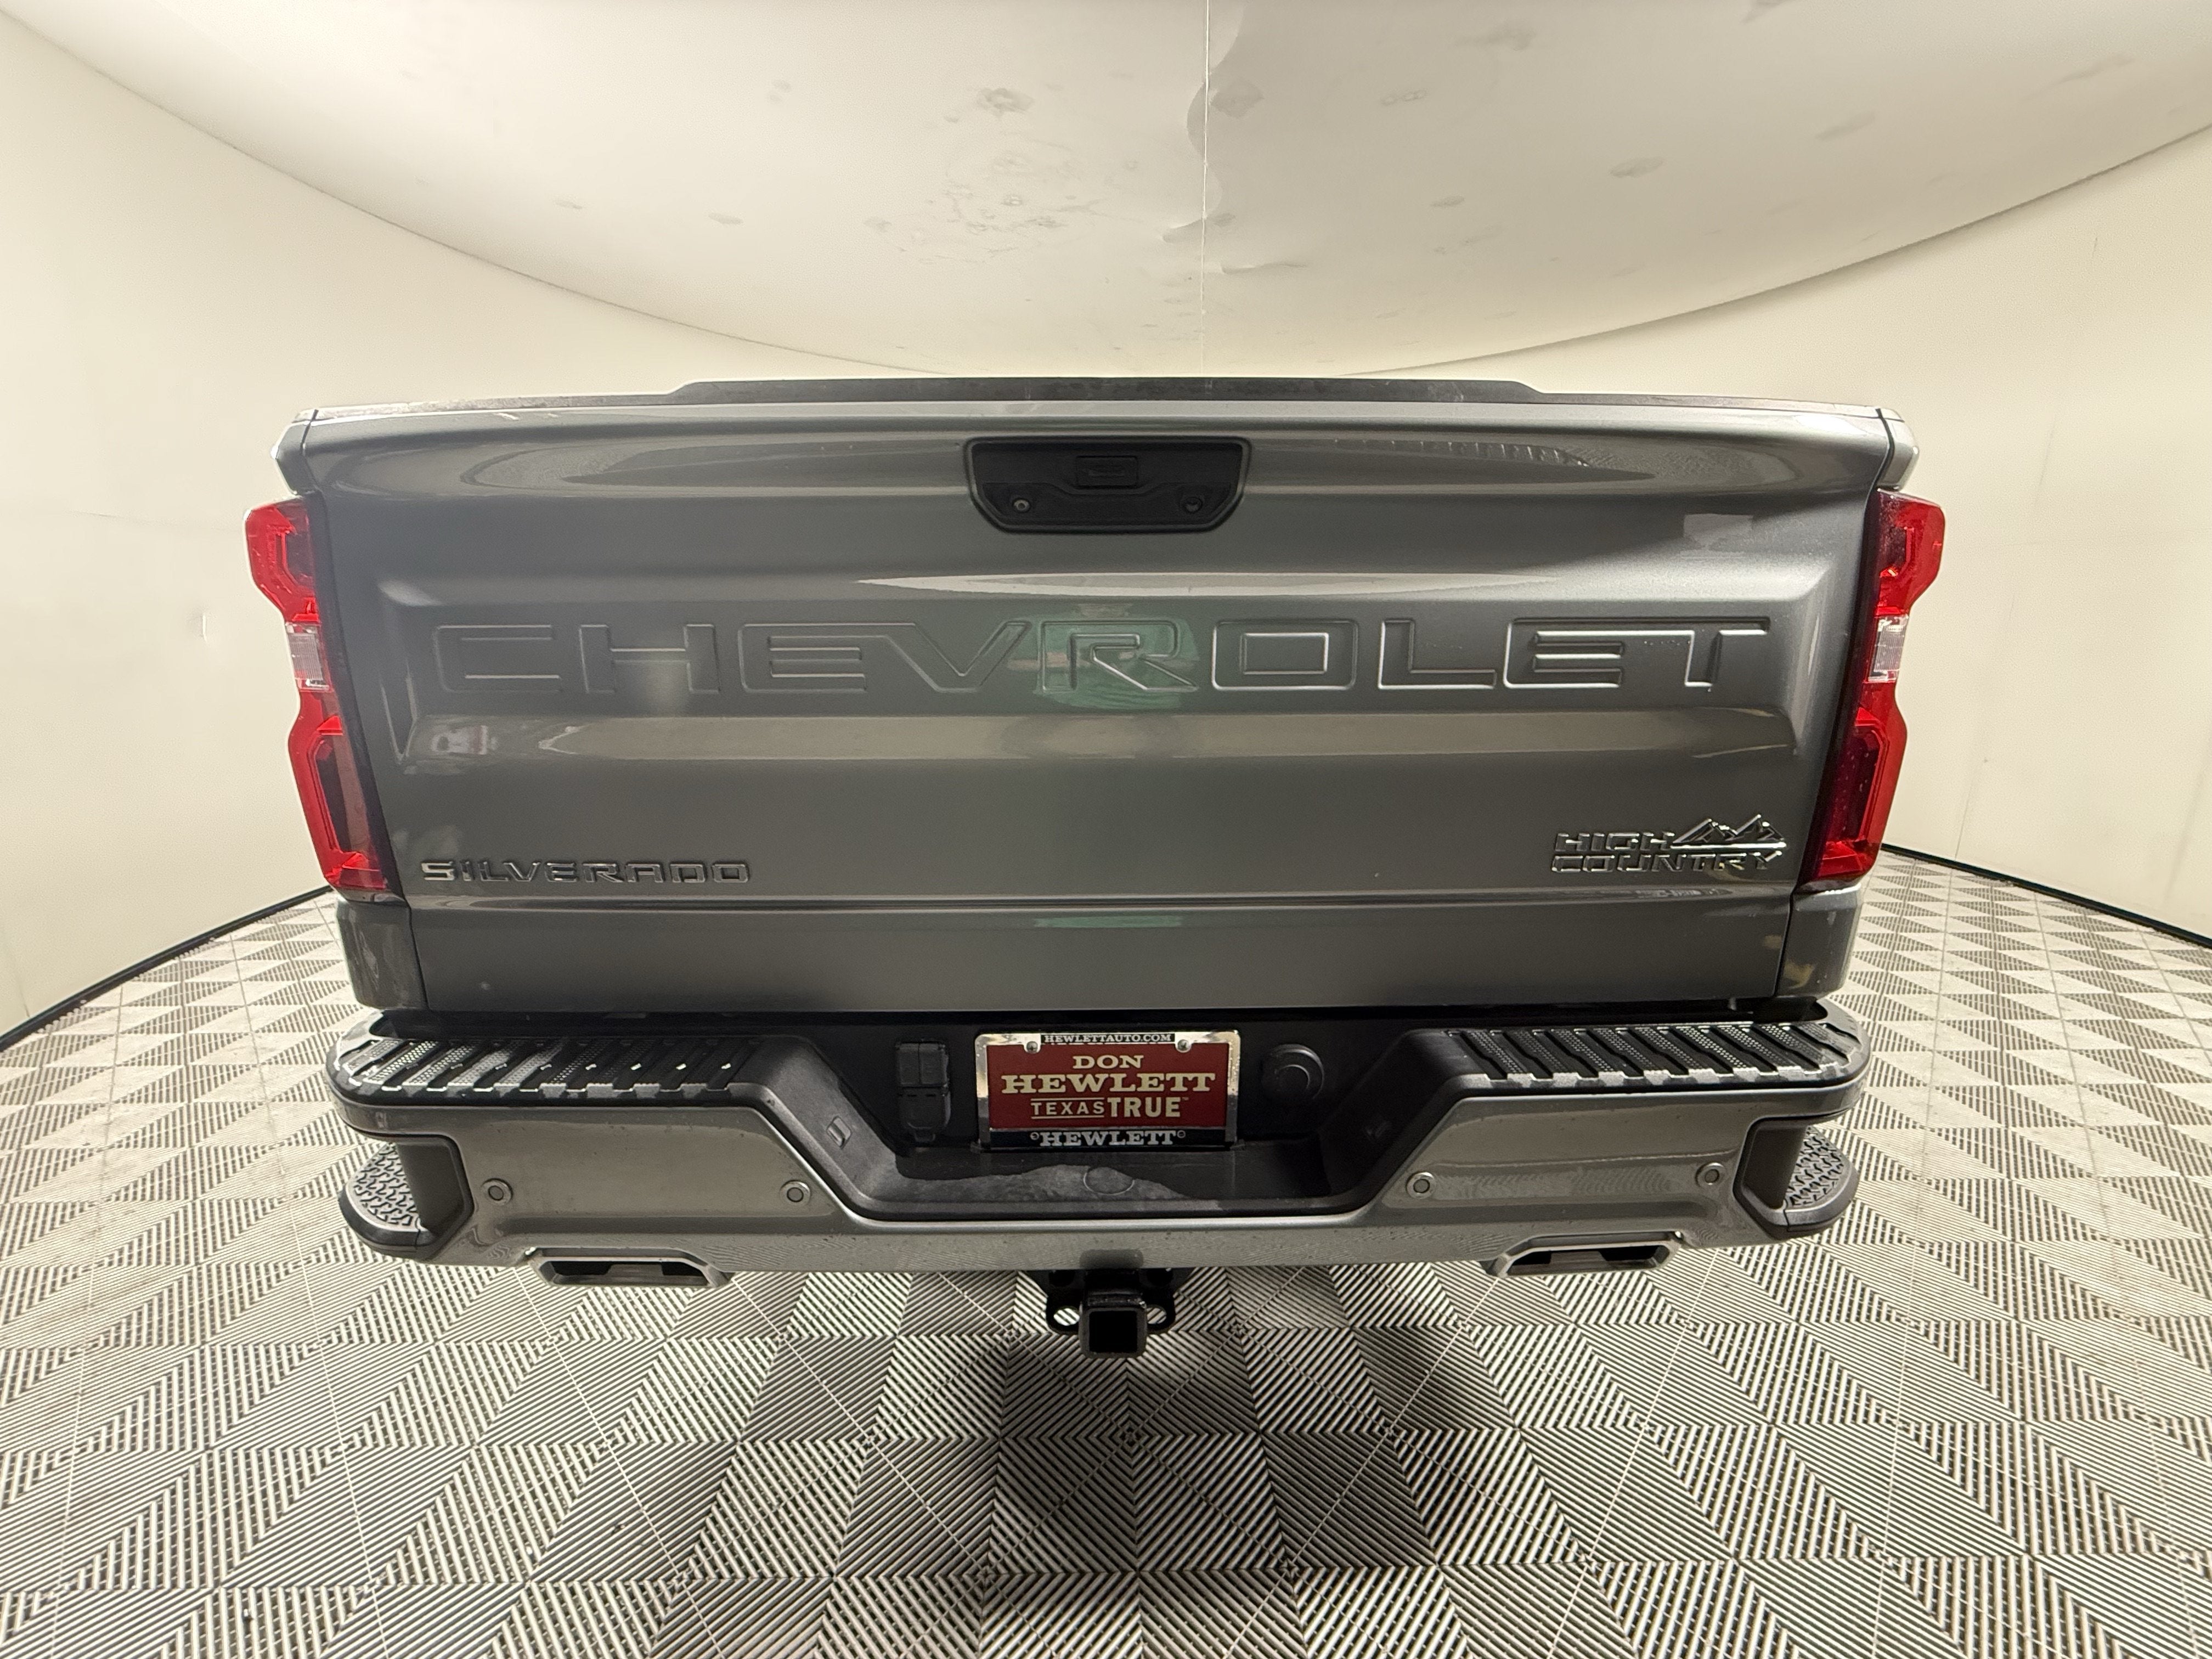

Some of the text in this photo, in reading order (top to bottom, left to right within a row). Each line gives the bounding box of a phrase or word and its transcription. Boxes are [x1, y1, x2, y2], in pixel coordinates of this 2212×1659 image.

[433, 617, 1771, 693] CHEVROLET
[1554, 832, 1675, 851] HIGH
[1551, 851, 1783, 872] COUNTRY
[421, 860, 749, 884] SILVERADO
[1044, 1034, 1172, 1043] HEWLETTAUTO.COM
[1072, 1054, 1144, 1069] DON
[1001, 1073, 1216, 1094] HEWLETT
[1031, 1102, 1105, 1116] TEXAS
[1040, 1130, 1176, 1147] HEWLETT
